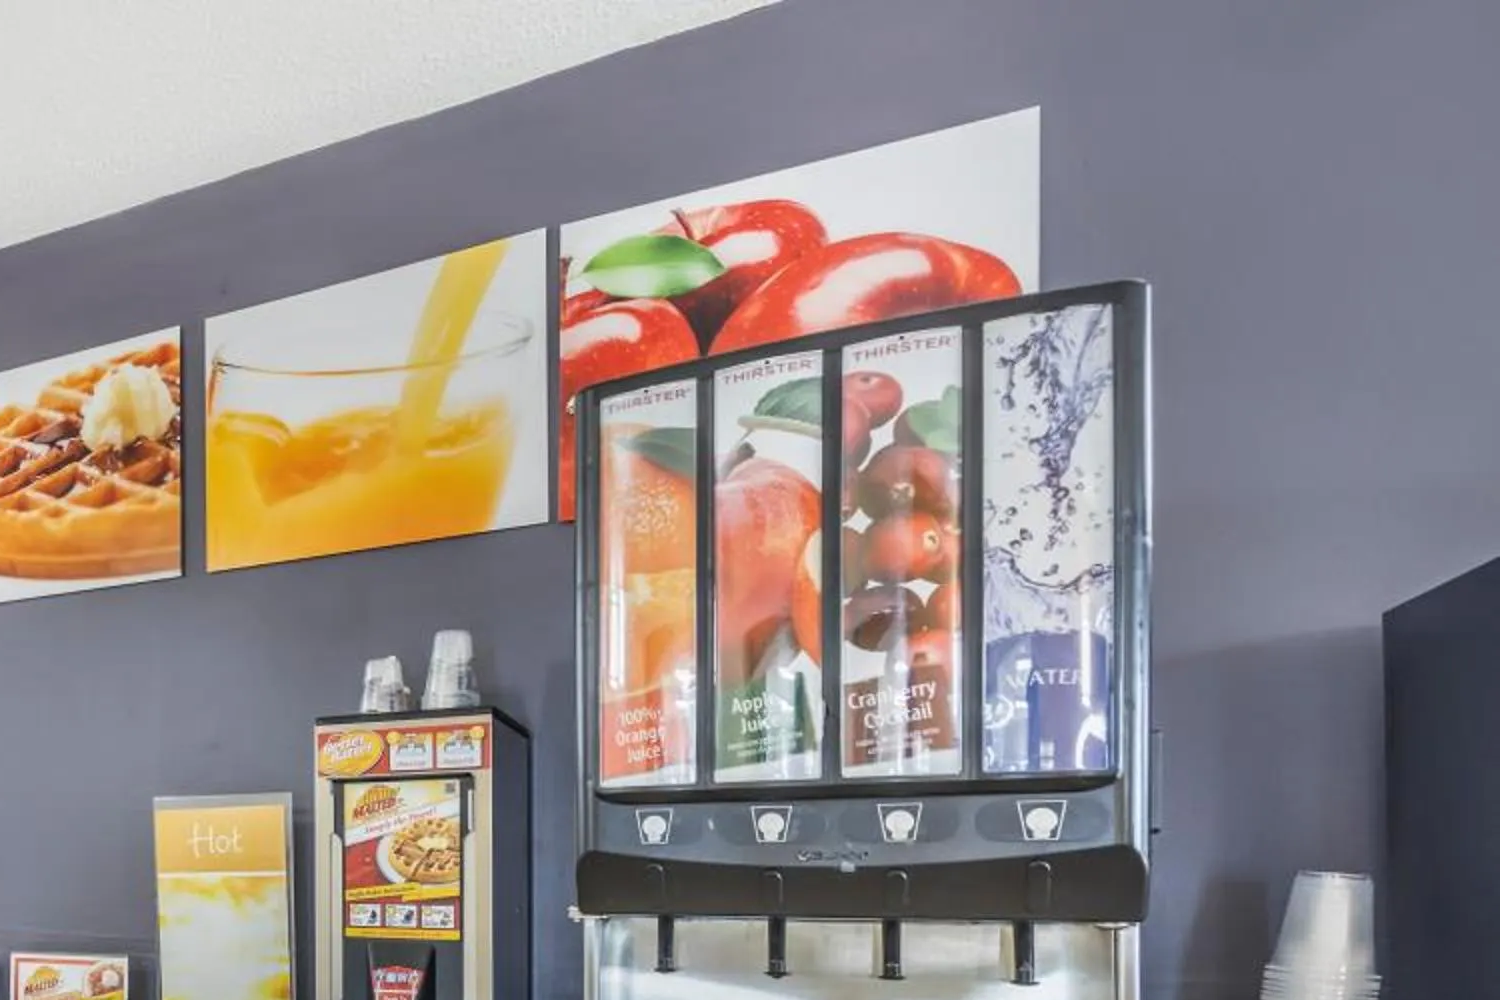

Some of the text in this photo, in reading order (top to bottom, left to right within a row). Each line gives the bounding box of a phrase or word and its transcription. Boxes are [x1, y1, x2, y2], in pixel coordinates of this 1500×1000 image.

[852, 335, 952, 363] THIRSTER
[723, 359, 813, 385] THIRSTER
[607, 388, 687, 415] THIRSTER
[187, 821, 243, 859] Hot
